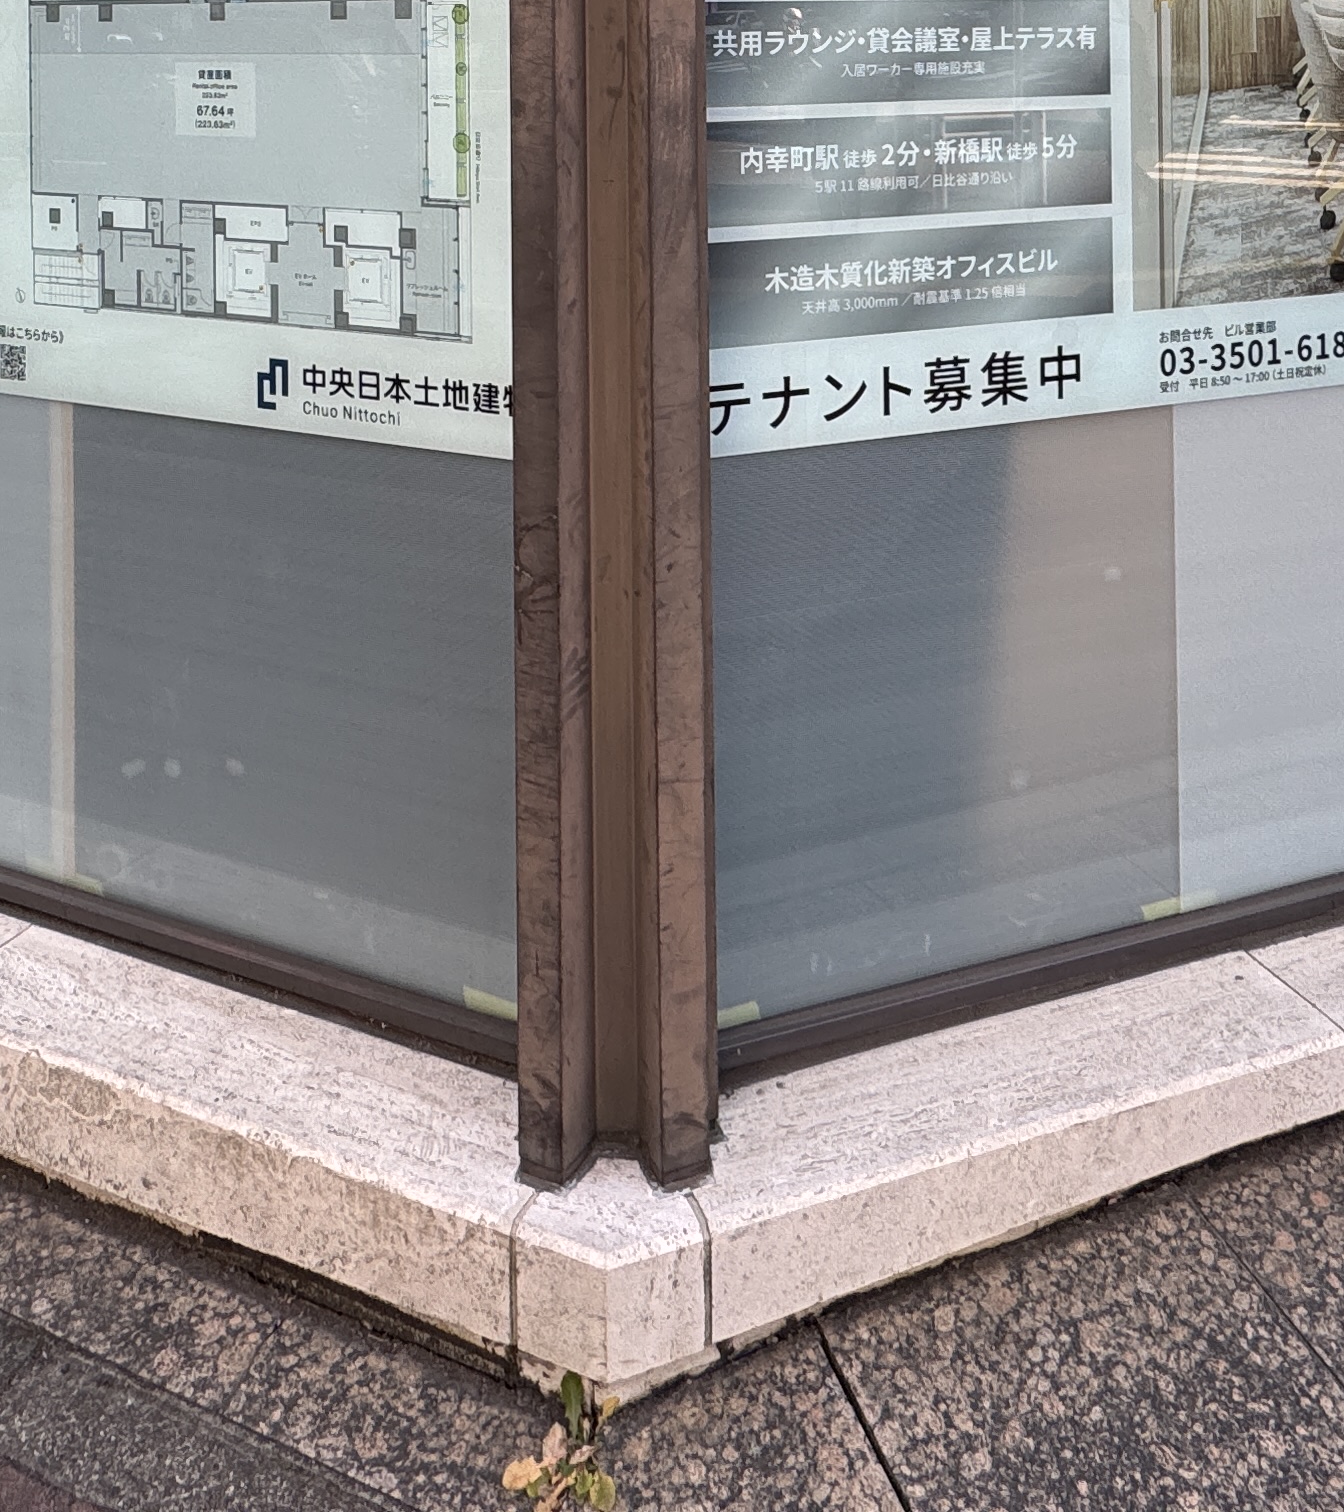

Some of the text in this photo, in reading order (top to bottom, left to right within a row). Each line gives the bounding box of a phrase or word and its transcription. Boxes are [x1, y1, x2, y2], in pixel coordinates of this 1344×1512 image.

[712, 24, 1097, 58] 共用ラウンジ・貸会議室・屋上テラス有
[764, 248, 1059, 294] 木造木質化新築オフィスビル
[1158, 320, 1278, 344] お問合せ先 ビル営業部
[709, 345, 1081, 436] テナント募集中
[1159, 380, 1180, 393] 受付
[1189, 377, 1209, 390] 平日
[1245, 370, 1270, 384] 17:00
[302, 400, 402, 427] Chuo Nittochi
